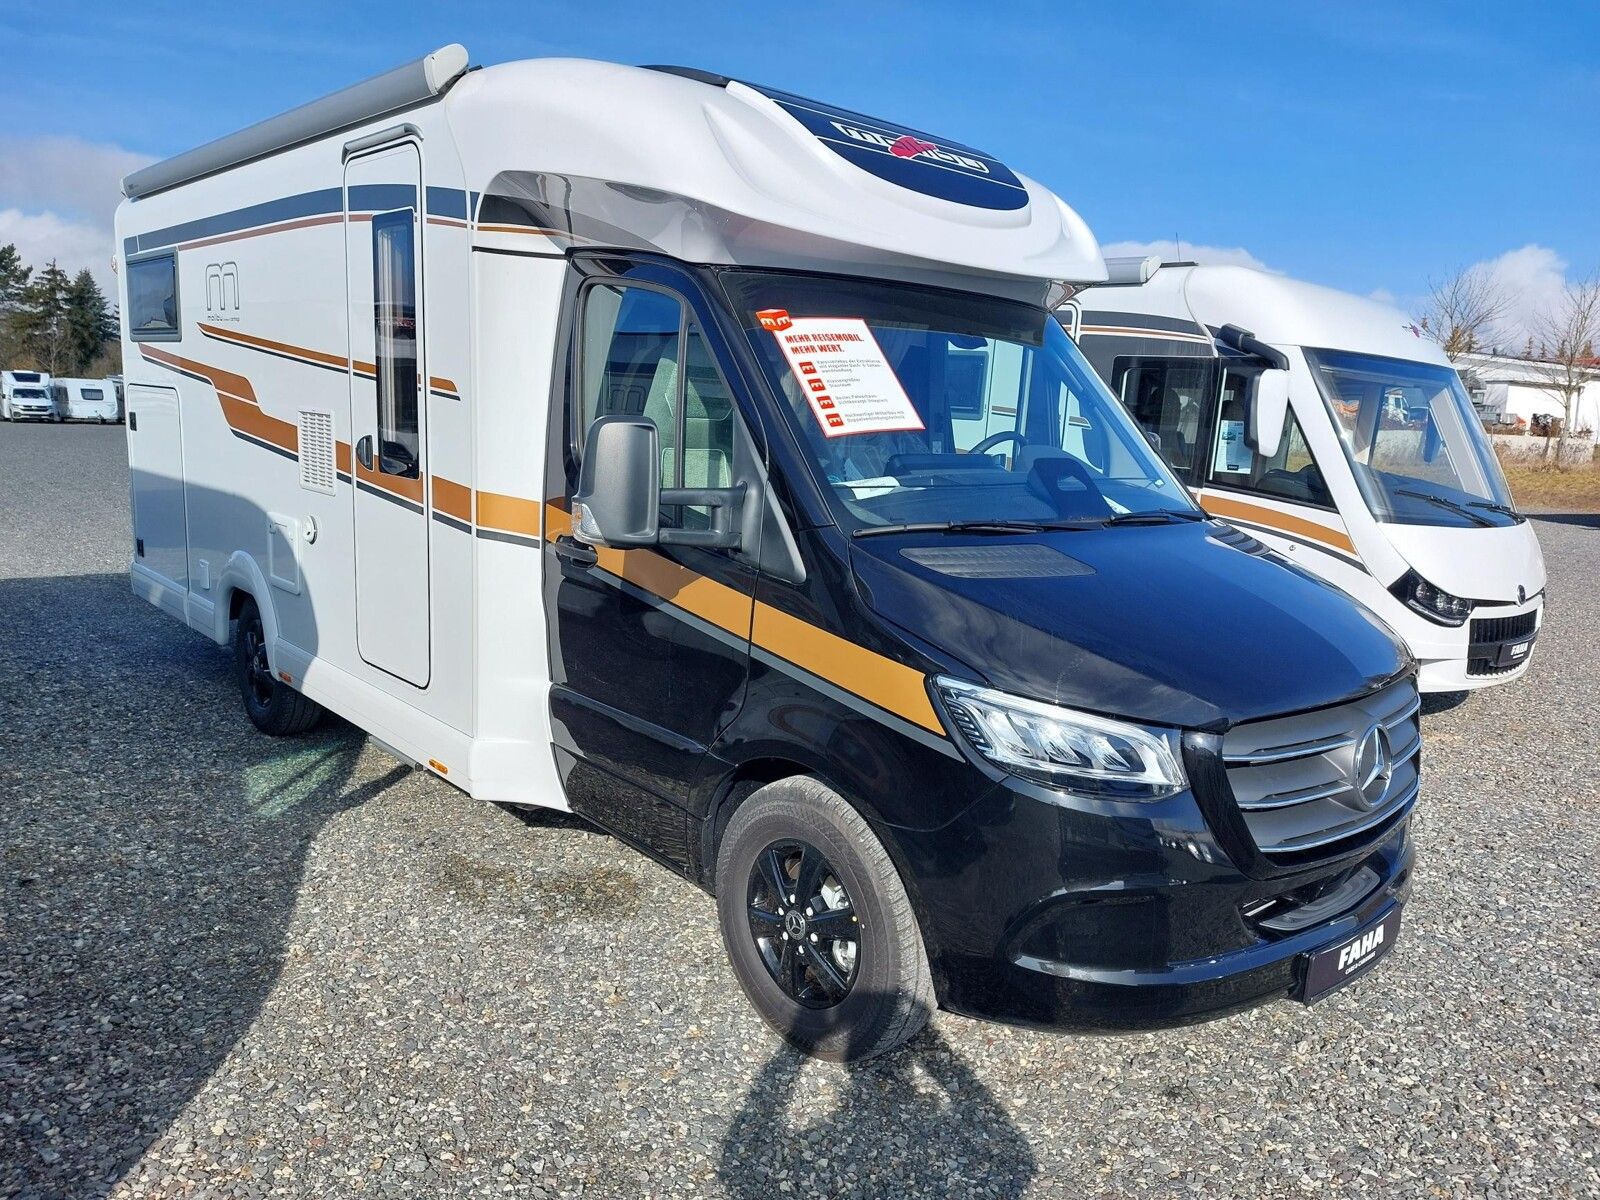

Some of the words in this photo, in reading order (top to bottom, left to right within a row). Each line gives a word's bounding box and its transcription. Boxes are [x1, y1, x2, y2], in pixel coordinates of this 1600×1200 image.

[784, 334, 812, 343] MEHR
[812, 333, 865, 342] REISEMOBIL.
[790, 344, 818, 355] MEHR
[818, 344, 845, 354] WERT.
[1338, 924, 1384, 971] FAHA
